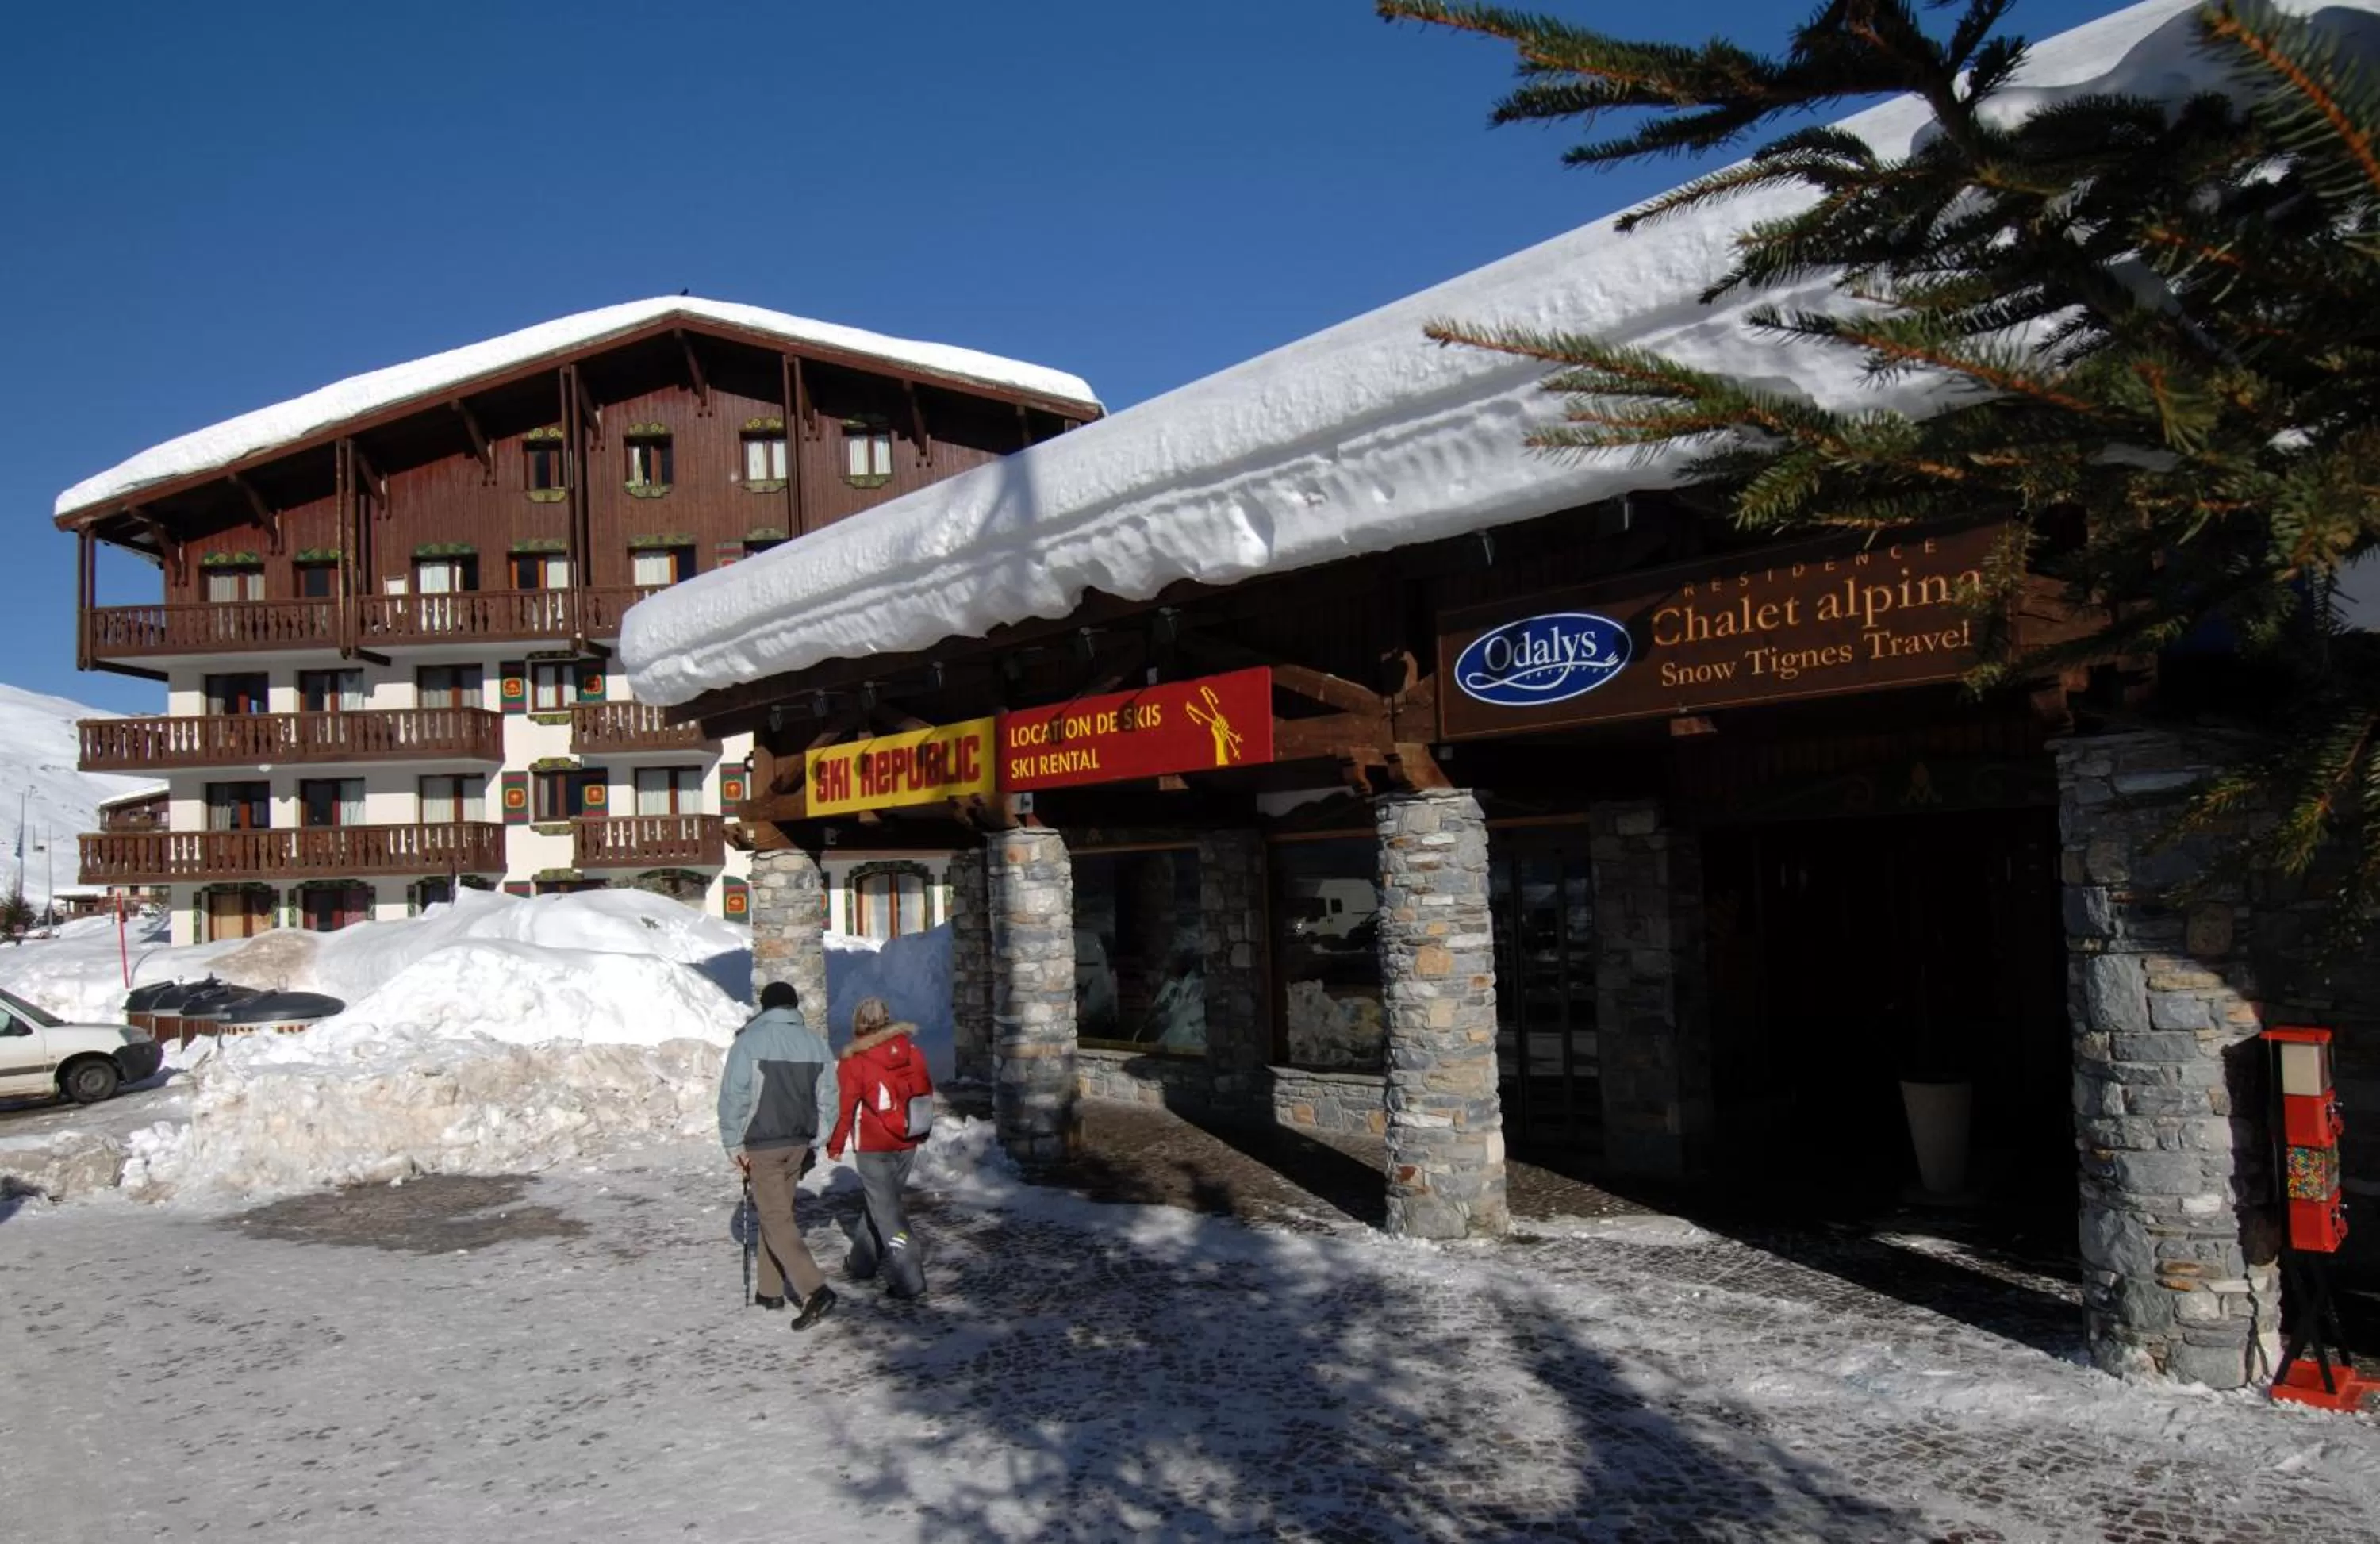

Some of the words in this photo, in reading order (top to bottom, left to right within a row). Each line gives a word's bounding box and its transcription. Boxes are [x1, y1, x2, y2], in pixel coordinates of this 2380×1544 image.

[1653, 594, 1801, 647] Chalet
[1484, 626, 1598, 673] Odalys
[1661, 660, 1737, 687] Snow
[1745, 643, 1853, 680] Tignes
[1864, 619, 1974, 659] Travel
[1011, 715, 1092, 748] LOCATION
[1096, 711, 1118, 734] DE
[1123, 704, 1162, 730] SKIS
[816, 756, 851, 804] SKI
[1011, 756, 1035, 779] SKI
[1039, 748, 1100, 775] RENTAL
